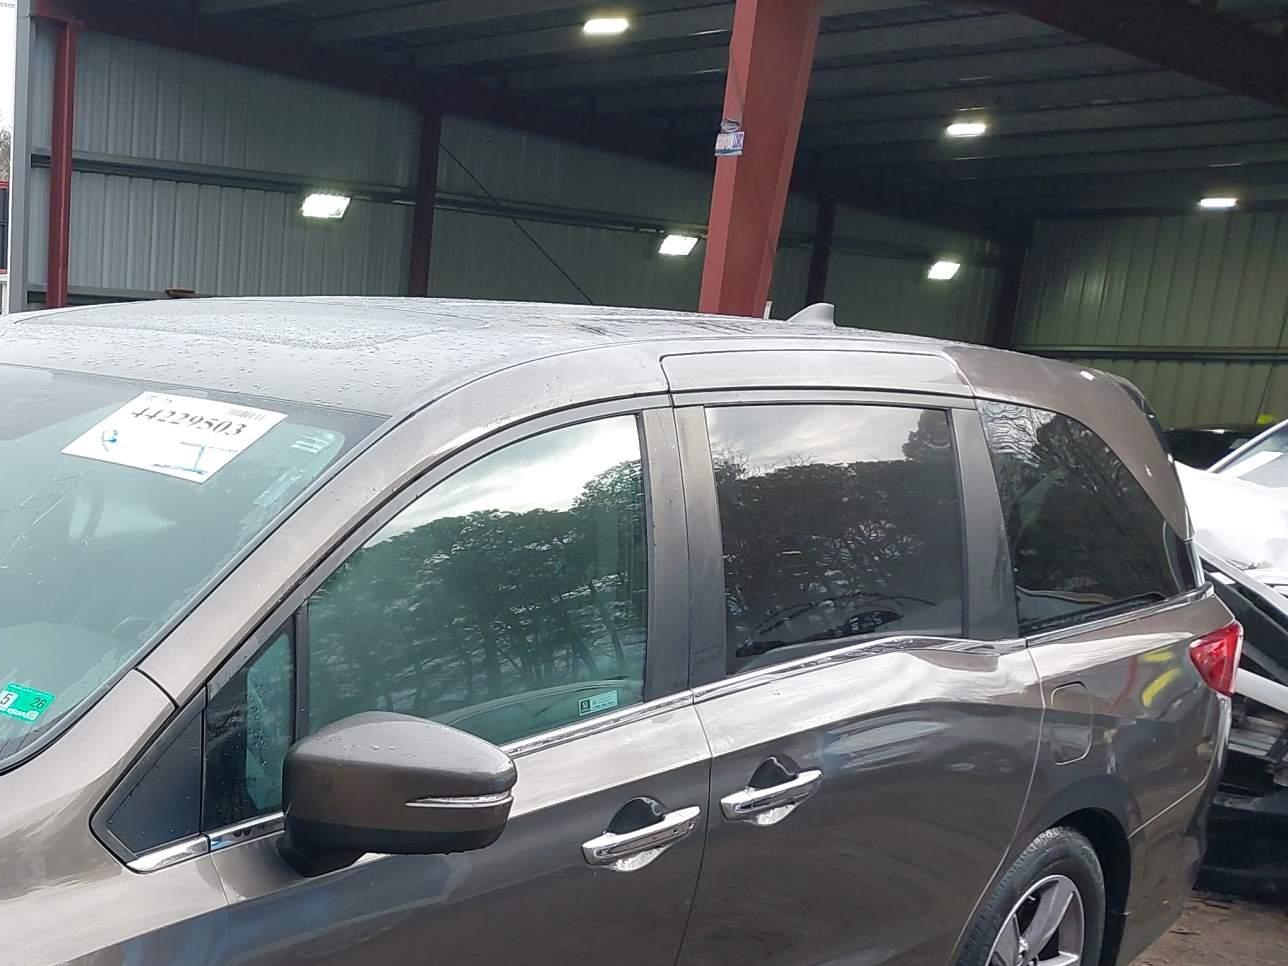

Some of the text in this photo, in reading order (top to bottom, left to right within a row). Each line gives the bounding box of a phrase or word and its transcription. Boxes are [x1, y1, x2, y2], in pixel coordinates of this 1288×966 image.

[131, 407, 247, 436] 44229503
[0, 693, 47, 709] 5 26
